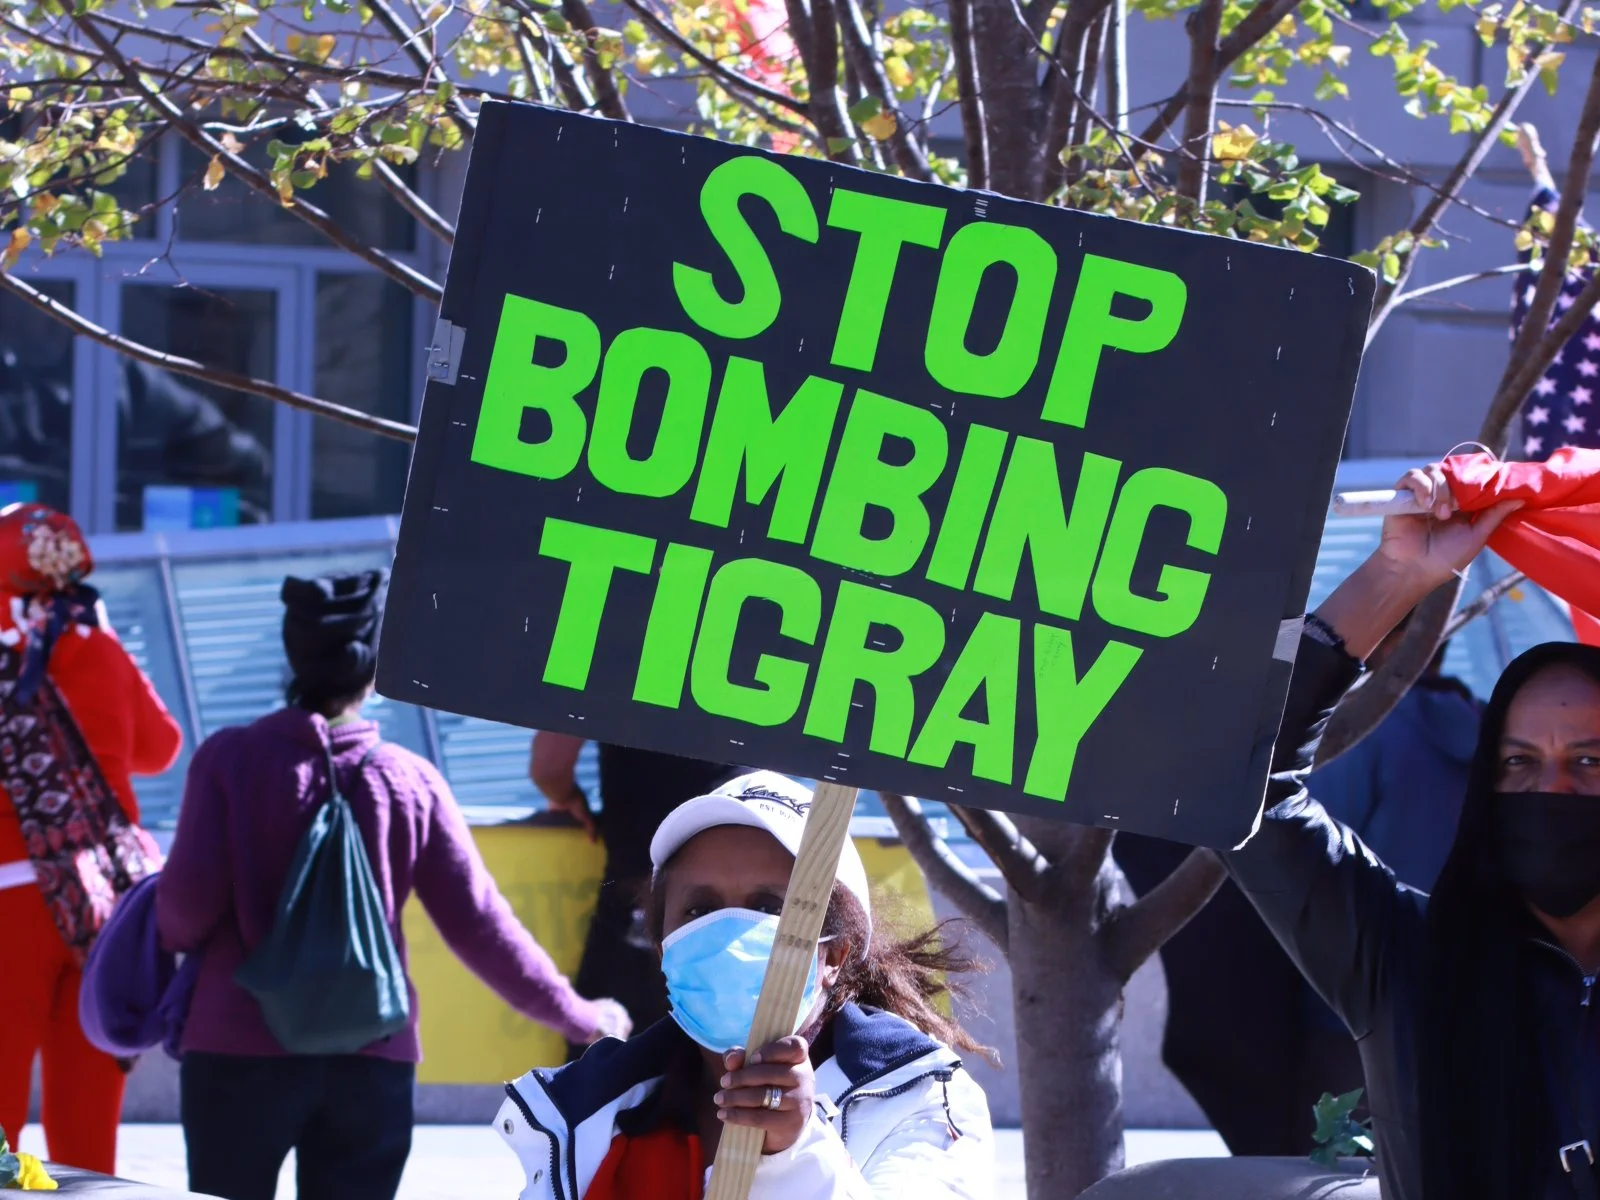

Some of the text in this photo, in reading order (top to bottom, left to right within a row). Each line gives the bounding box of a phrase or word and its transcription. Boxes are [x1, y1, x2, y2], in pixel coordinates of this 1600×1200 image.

[672, 156, 1187, 428] STOP
[471, 294, 1227, 637] BOMBING
[539, 517, 1142, 802] TIGRAY
